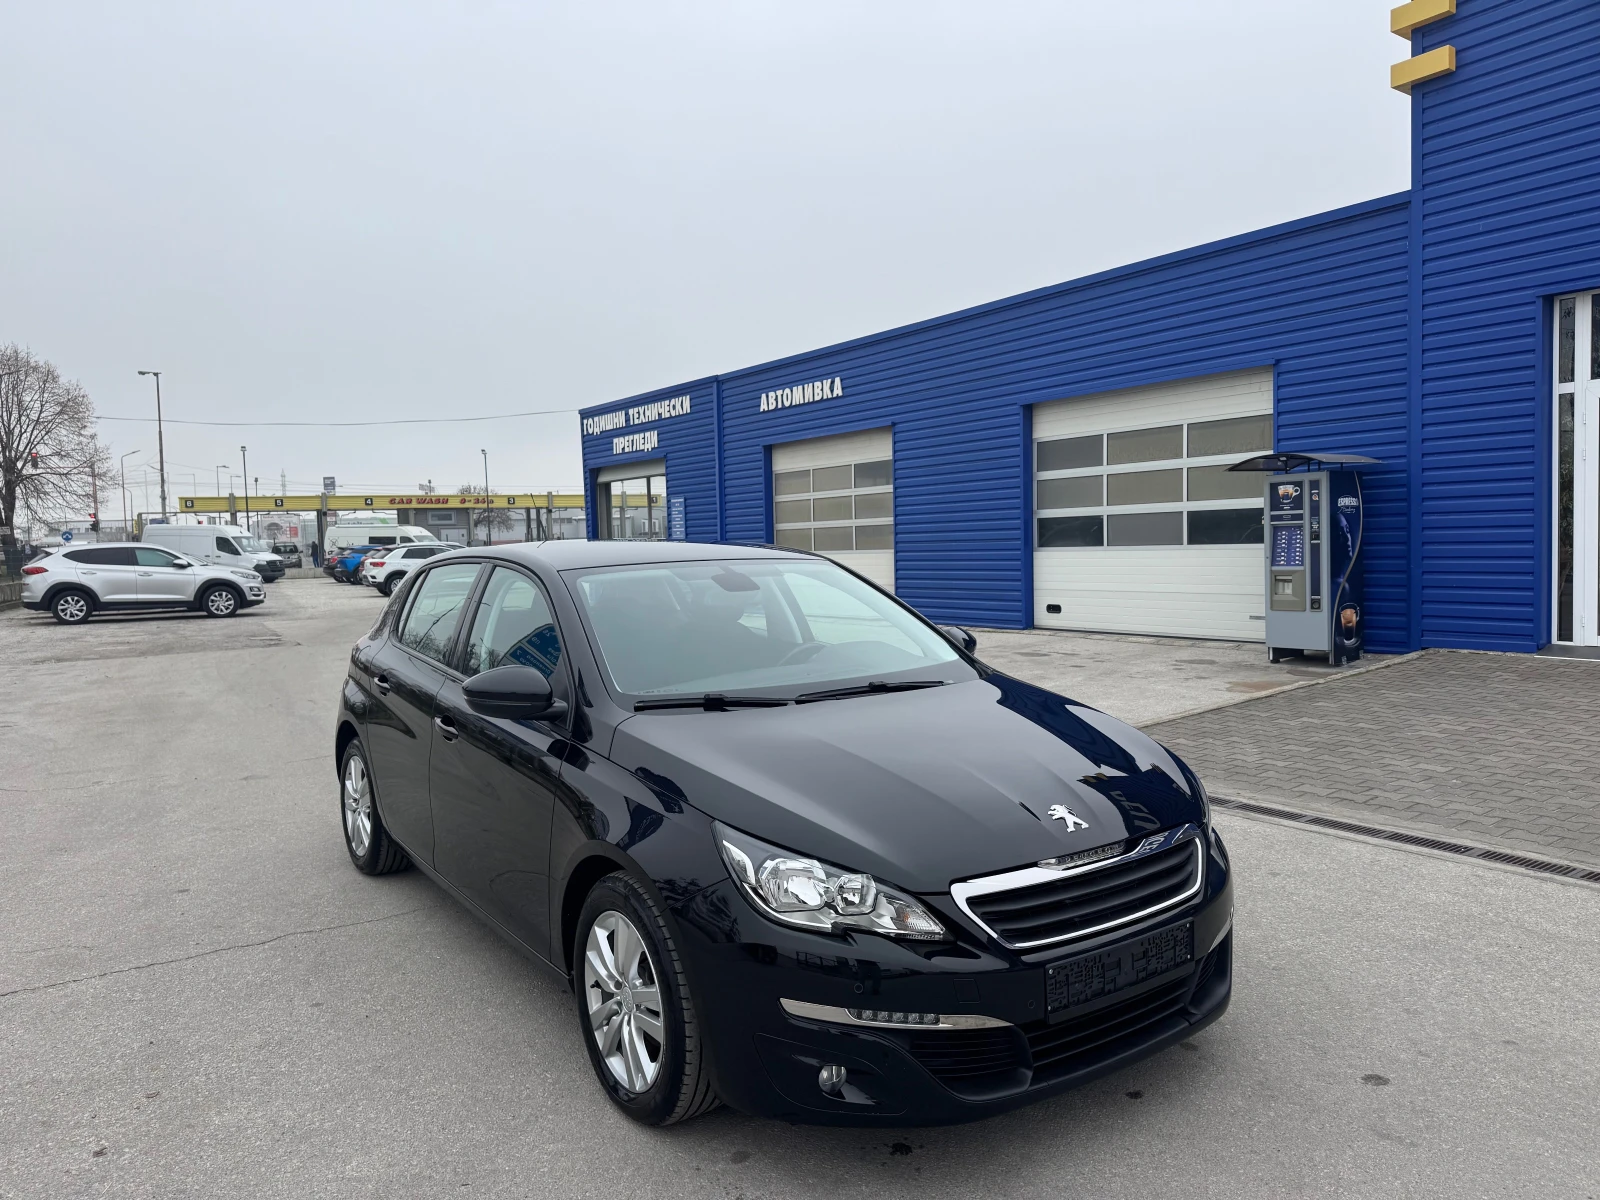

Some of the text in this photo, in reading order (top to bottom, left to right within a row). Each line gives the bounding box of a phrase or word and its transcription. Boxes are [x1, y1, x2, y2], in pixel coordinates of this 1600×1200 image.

[760, 377, 843, 412] АВТОМИВКА
[583, 395, 691, 436] ГОДИШНИ ТЕХНИЧЕСКИ
[613, 430, 658, 455] ПРЕГЛЕДИ
[389, 497, 413, 505] CAR
[416, 497, 449, 505] WASH
